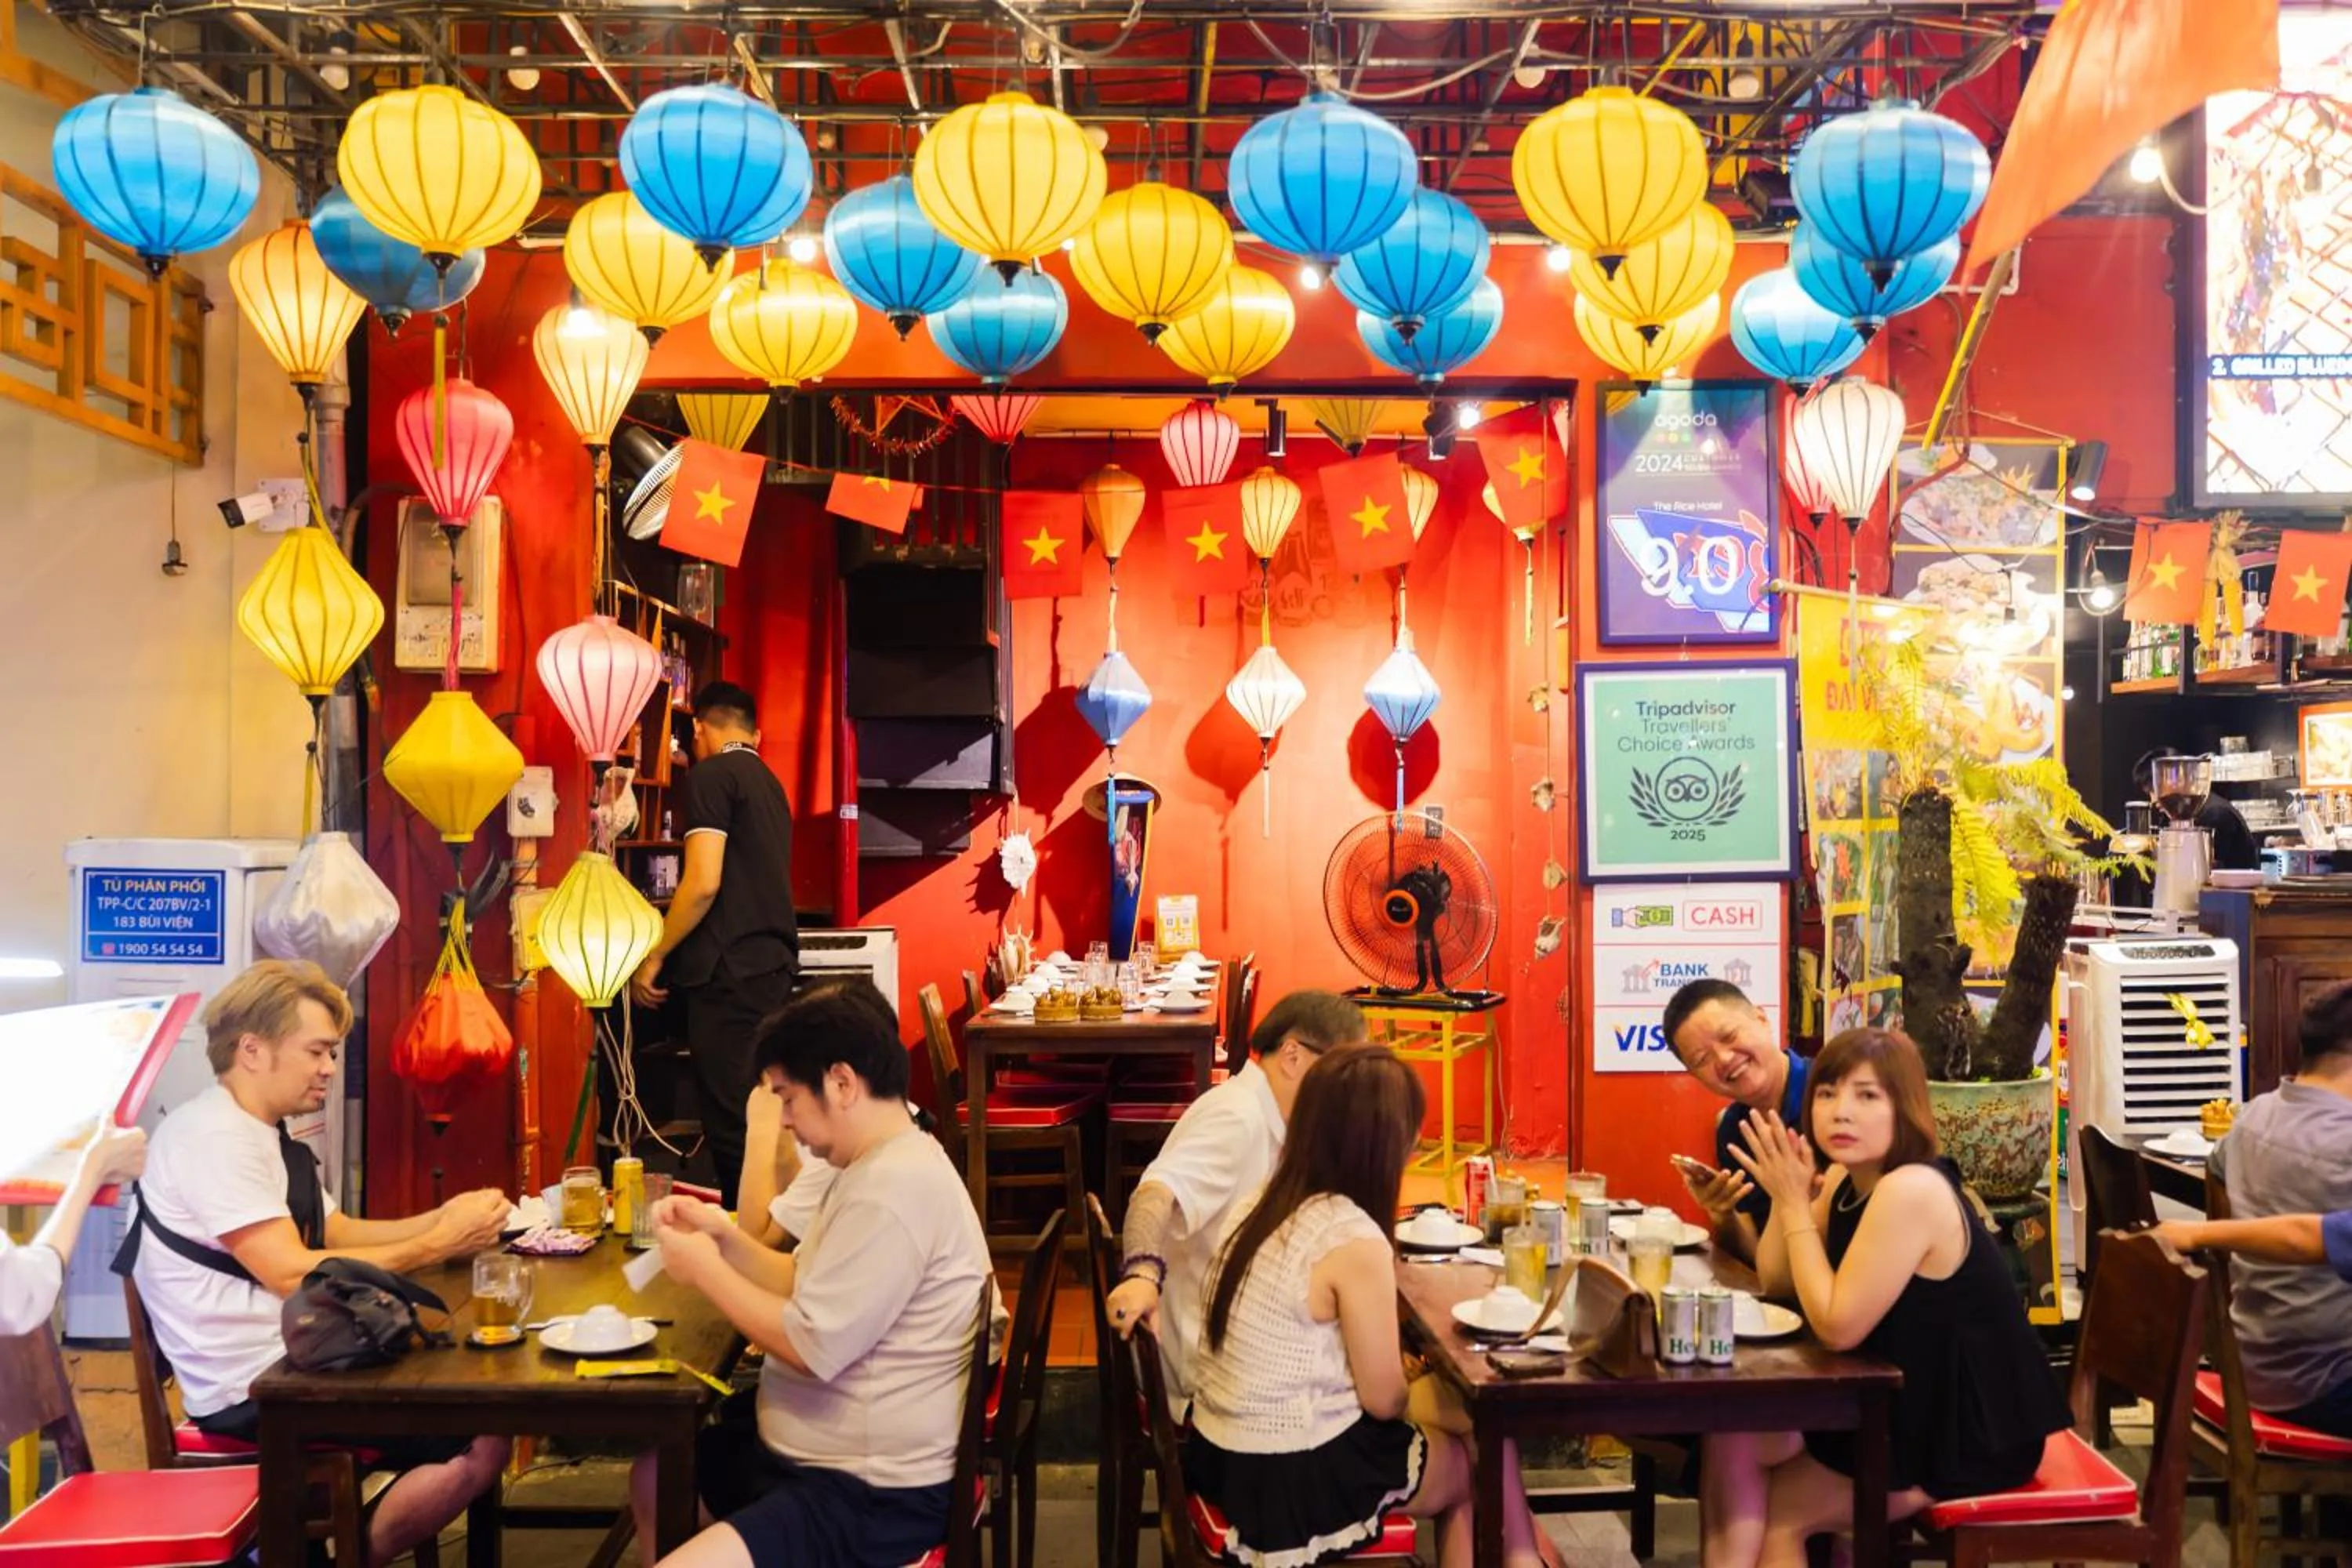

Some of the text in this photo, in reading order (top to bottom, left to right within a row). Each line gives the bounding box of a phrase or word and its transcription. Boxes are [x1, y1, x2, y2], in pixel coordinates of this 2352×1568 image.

[1654, 409, 1717, 430] agoda
[1635, 454, 1682, 473] 2024
[1641, 535, 1738, 597] 9.0
[1635, 700, 1736, 720] Tripadvisor
[1617, 735, 1755, 753] Choice Awards
[1671, 829, 1706, 841] 2025
[125, 877, 166, 893] PHÂN
[97, 896, 211, 912] TPP-C/C 207BV/2-1
[114, 916, 136, 927] 183
[1690, 906, 1755, 926] CASH
[118, 943, 204, 956] 1900 54 54 54
[1660, 963, 1709, 977] BANK
[1614, 1025, 1672, 1052] VIS
